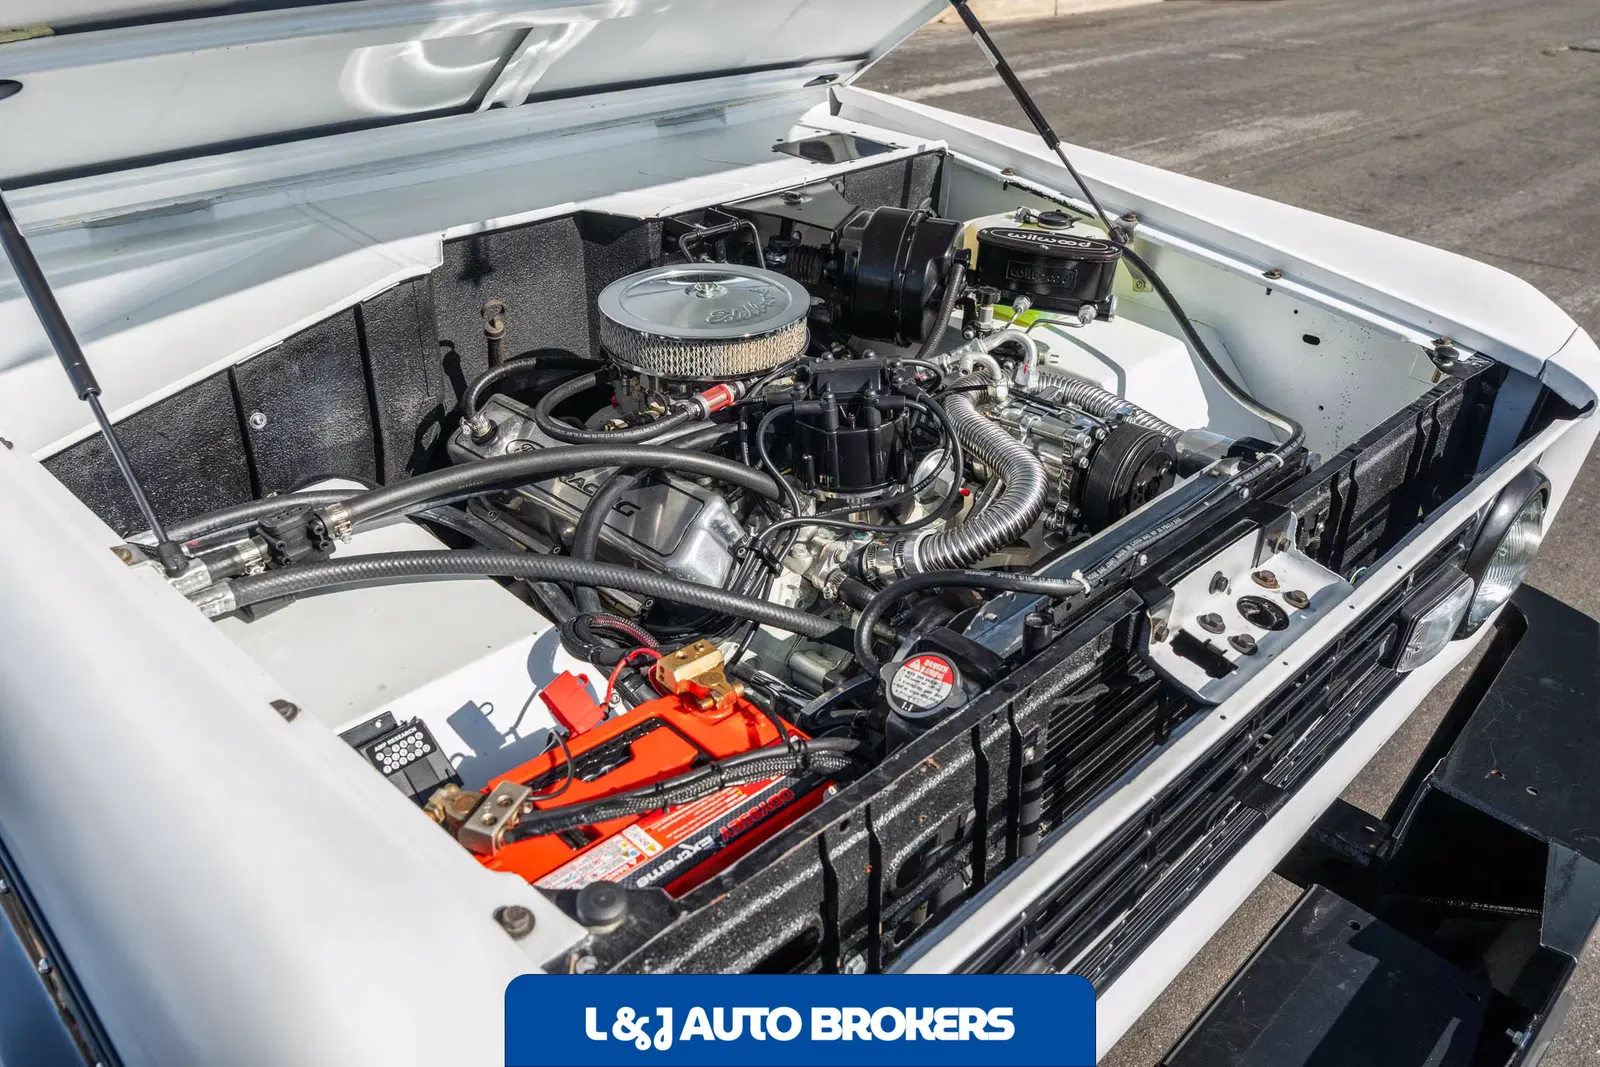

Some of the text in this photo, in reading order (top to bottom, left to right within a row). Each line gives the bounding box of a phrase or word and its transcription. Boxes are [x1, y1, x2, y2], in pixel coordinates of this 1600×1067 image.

[1007, 232, 1091, 248] wilwood
[561, 471, 641, 517] RACG
[901, 701, 913, 712] 1.1
[387, 726, 417, 745] RESEARCH
[719, 787, 795, 841] ODYSSEY
[636, 835, 716, 889] Extreme
